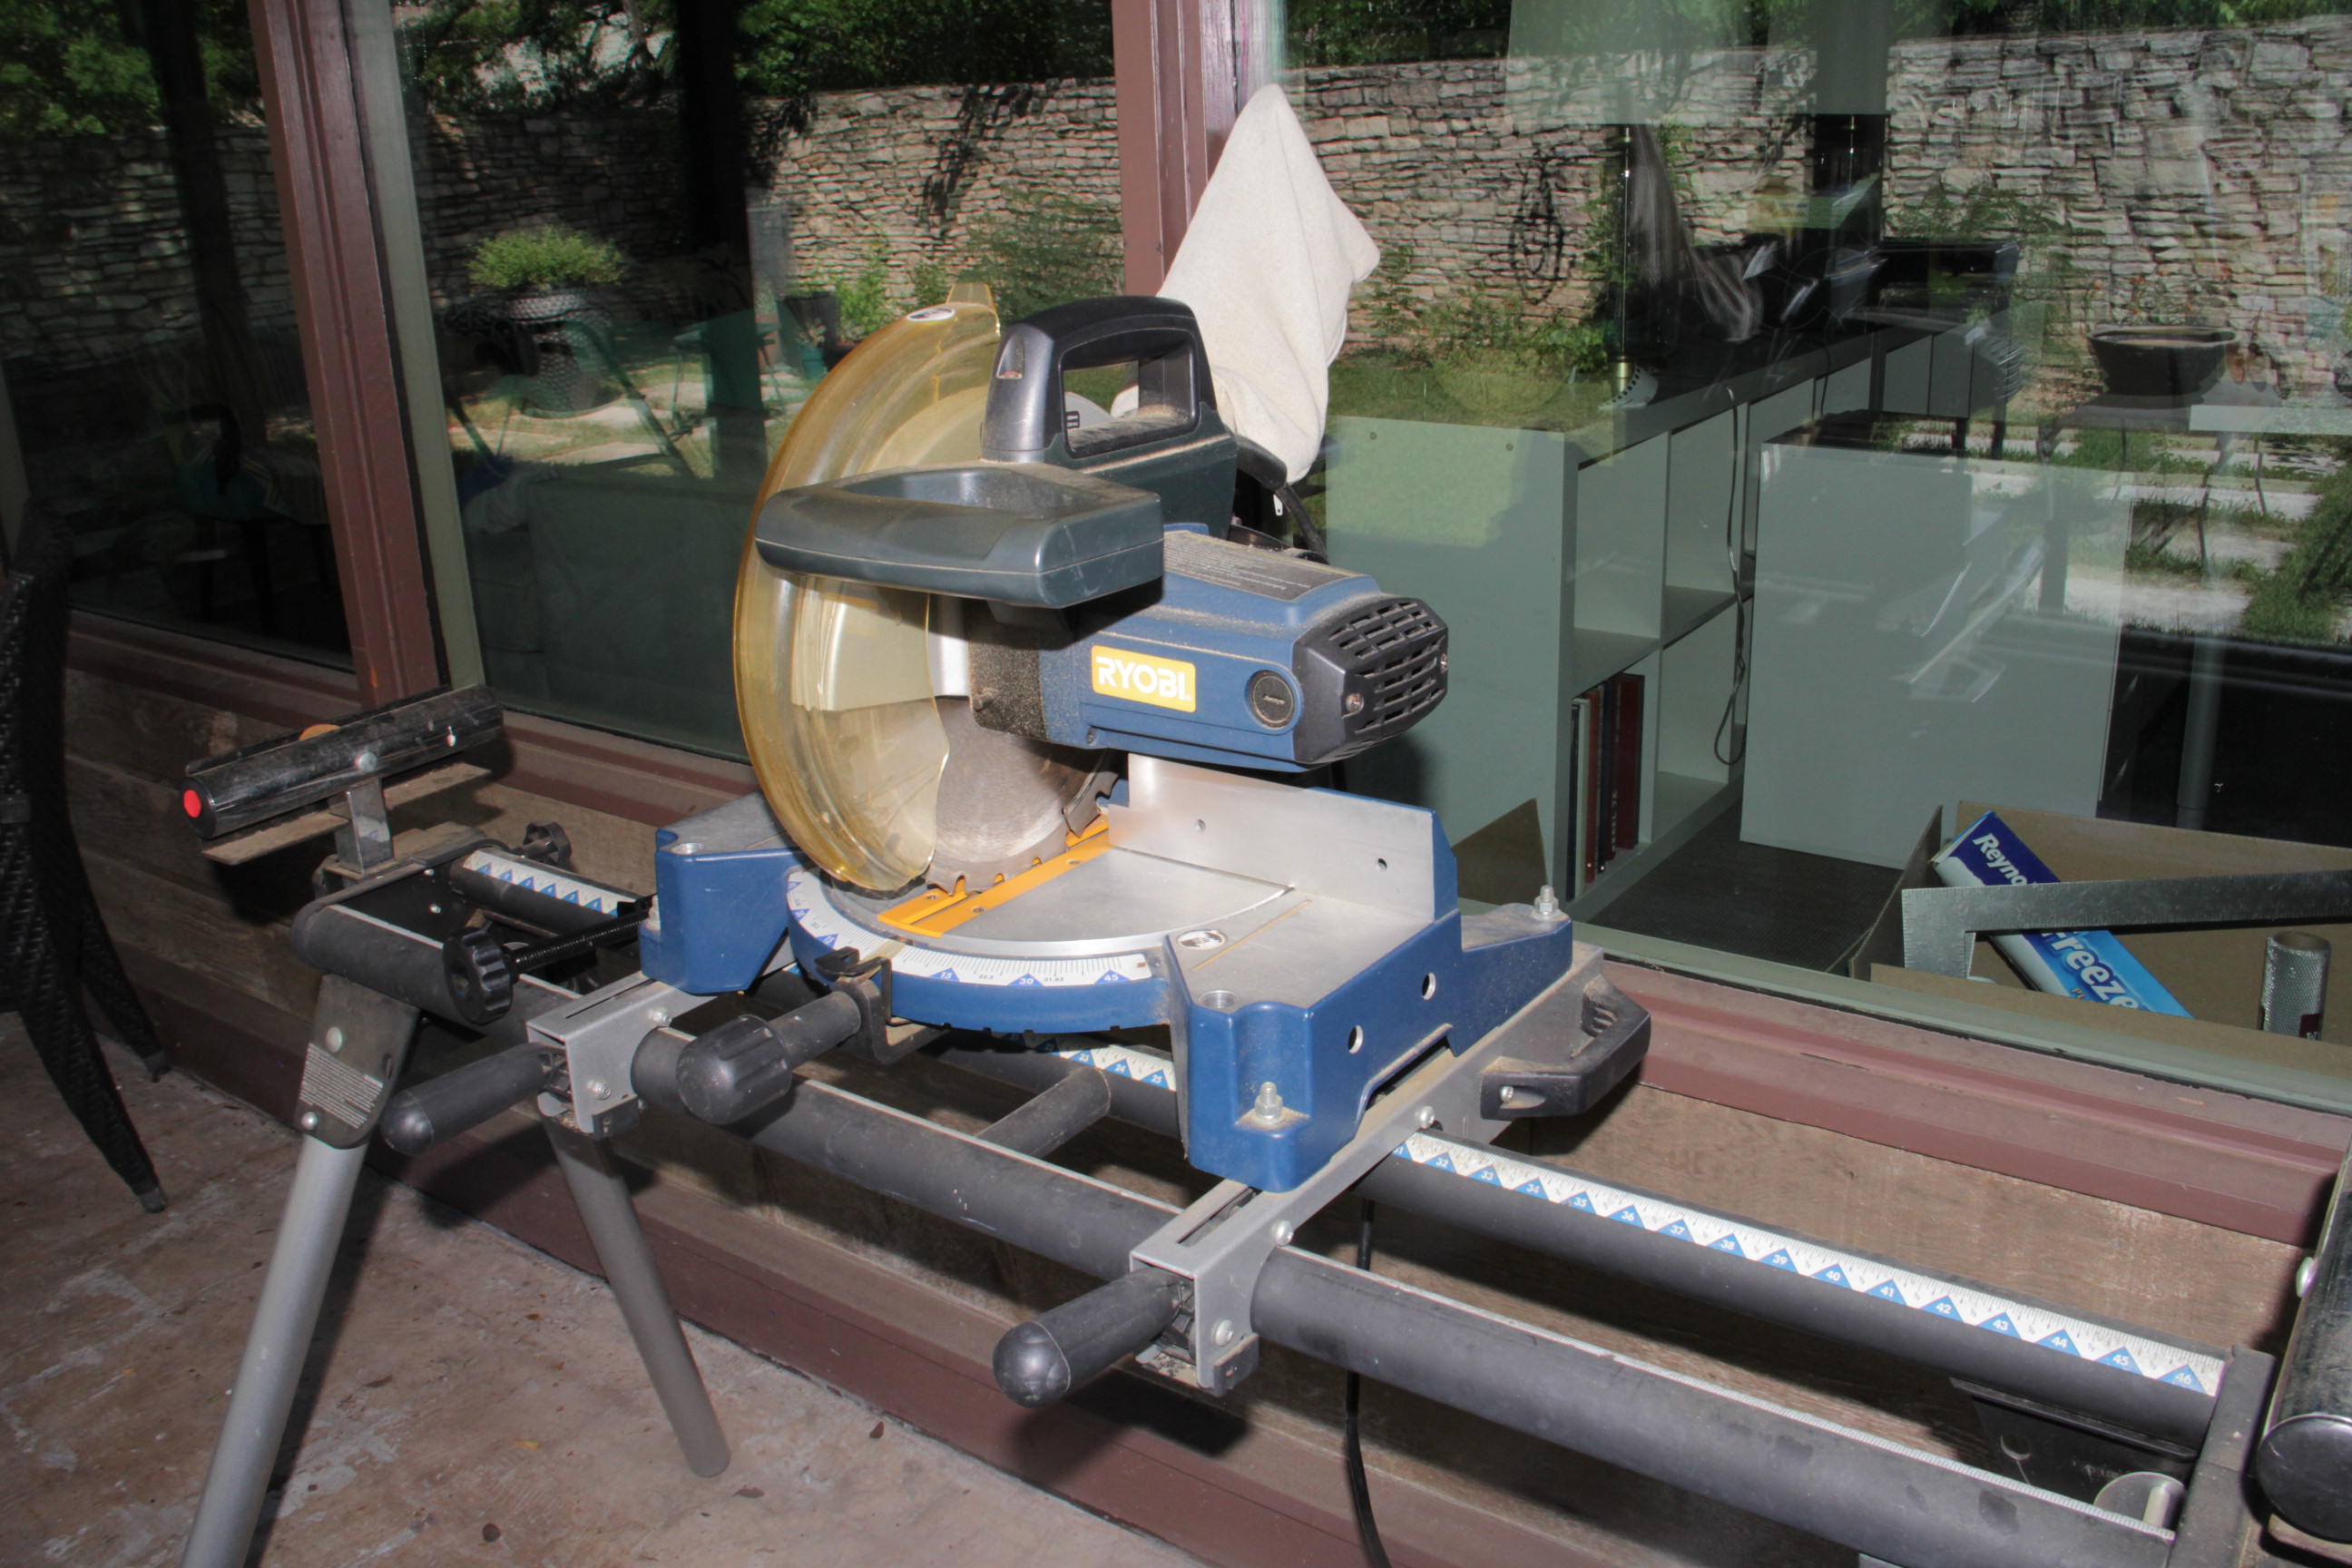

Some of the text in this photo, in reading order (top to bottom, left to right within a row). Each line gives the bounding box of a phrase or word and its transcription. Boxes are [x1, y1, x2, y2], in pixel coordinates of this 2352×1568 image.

[1095, 656, 1186, 701] RYOBI
[1972, 832, 2033, 886] Reyno
[940, 971, 954, 979] 15
[1018, 977, 1034, 985] 30
[2042, 932, 2139, 1009] reeze
[1078, 1053, 1090, 1062] 23
[1115, 1063, 1126, 1073] 24
[1151, 1073, 1162, 1084] 25
[1436, 1157, 1449, 1169] 32
[1480, 1170, 1494, 1181] 33
[1526, 1181, 1541, 1194] 34
[1573, 1197, 1588, 1209] 35
[1621, 1210, 1635, 1222] 36
[1670, 1224, 1685, 1236] 37
[1720, 1239, 1735, 1251] 38
[1772, 1254, 1788, 1266] 39
[1826, 1269, 1841, 1282] 40
[1879, 1286, 1895, 1298] 41
[1936, 1302, 1952, 1315] 42
[1993, 1318, 2009, 1332] 43
[2051, 1336, 2068, 1349] 44
[2112, 1353, 2130, 1367] 45
[2174, 1372, 2192, 1386] 46
